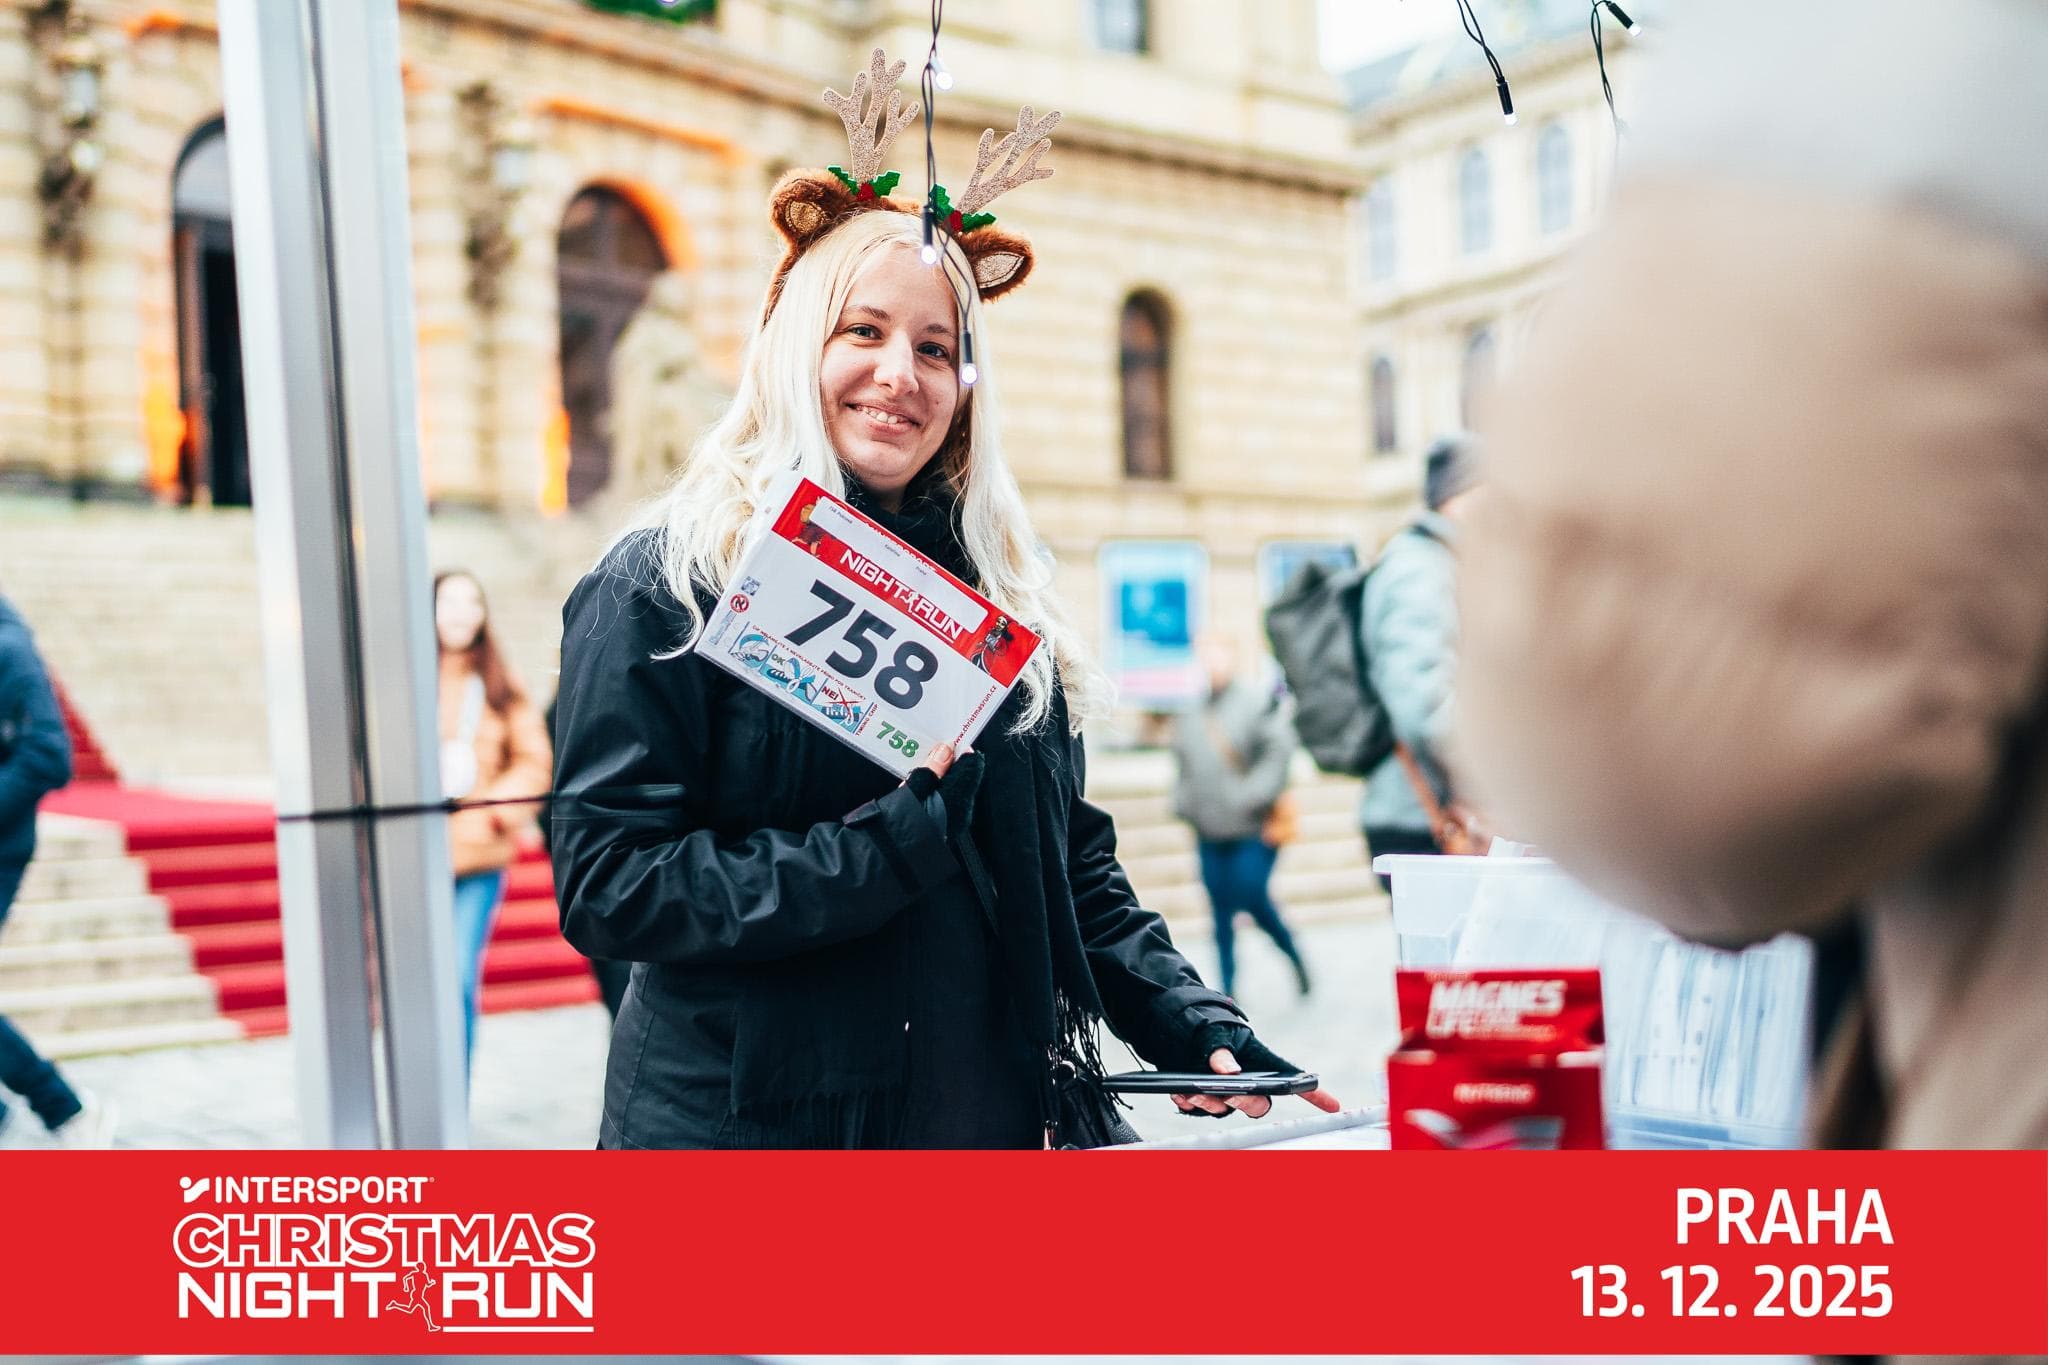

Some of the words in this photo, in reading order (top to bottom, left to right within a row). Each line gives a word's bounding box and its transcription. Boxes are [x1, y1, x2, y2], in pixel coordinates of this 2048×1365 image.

[840, 549, 911, 599] NIGHT
[912, 593, 964, 640] RUN
[771, 653, 786, 666] OK
[783, 578, 939, 710] 758
[876, 720, 920, 758] 758
